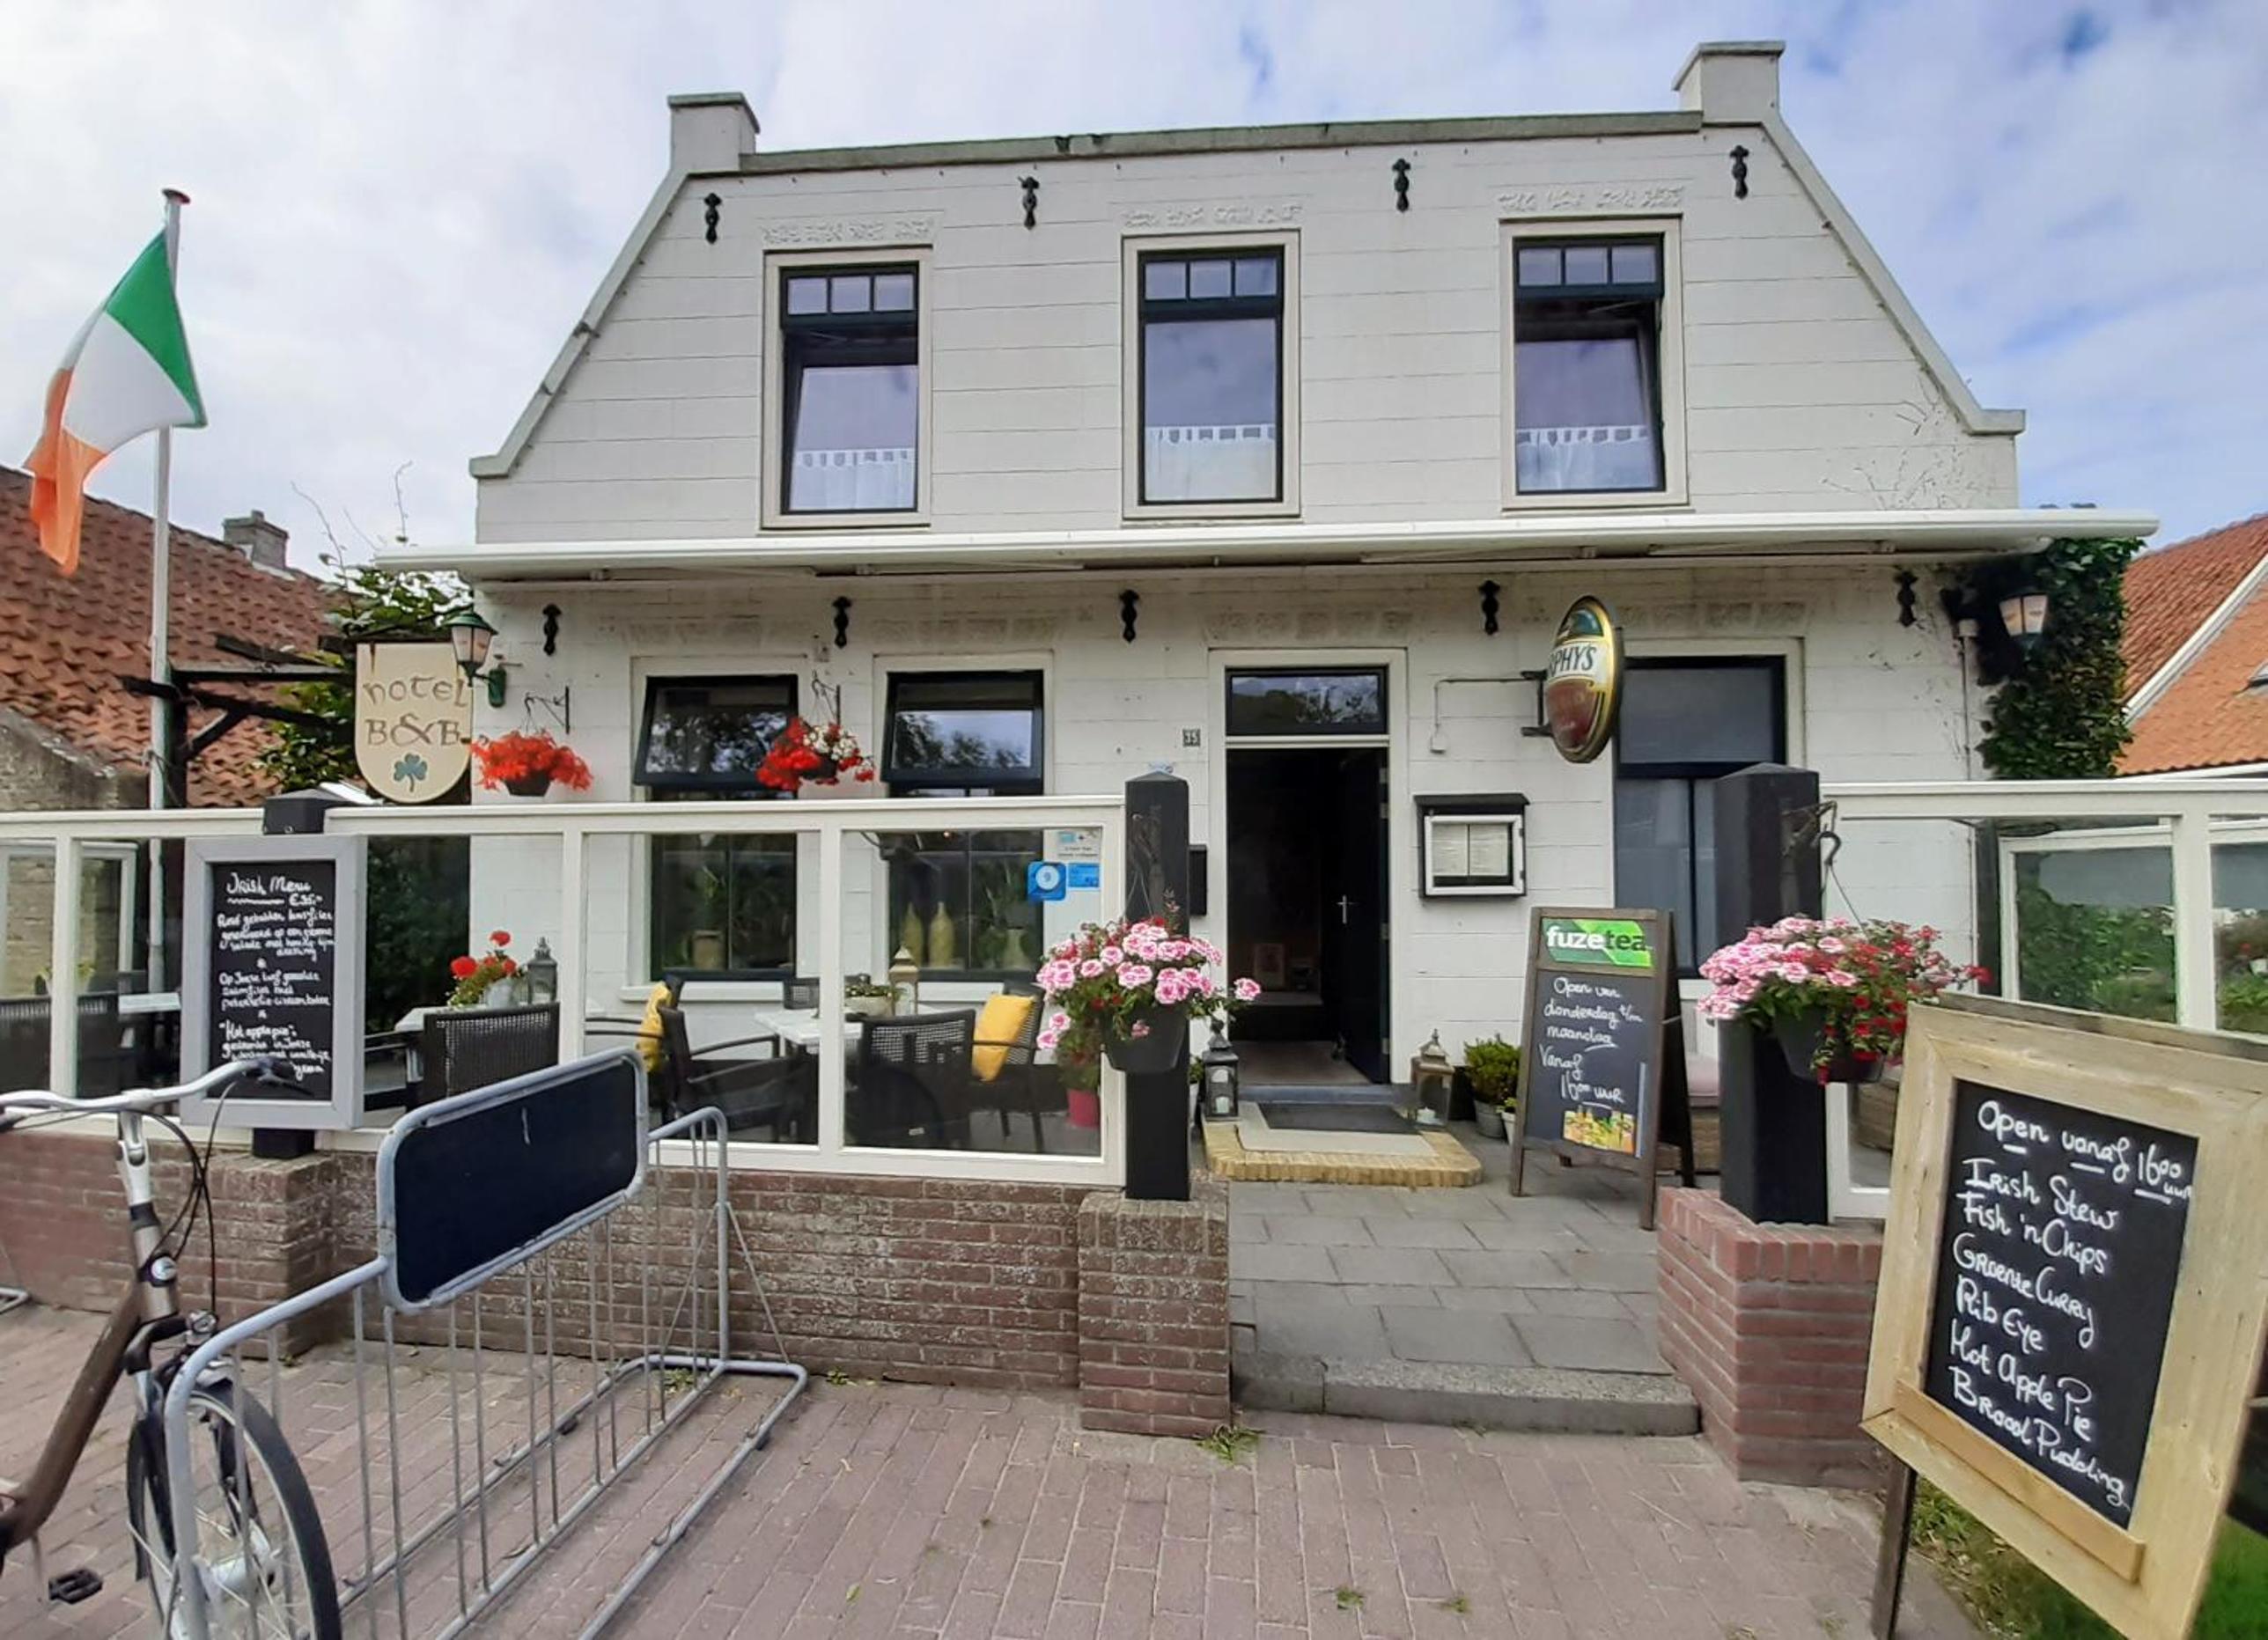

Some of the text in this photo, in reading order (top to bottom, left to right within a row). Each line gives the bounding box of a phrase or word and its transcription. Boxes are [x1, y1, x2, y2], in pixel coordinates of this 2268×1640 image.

[226, 871, 312, 895] Irish Menu
[1543, 997, 1620, 1030] donderdag
[1553, 976, 1592, 998] Open
[1977, 1100, 2050, 1142] Open
[2061, 1136, 2131, 1184] vanaf
[1955, 1190, 2012, 1236] Fish
[2042, 1217, 2108, 1275] Chips
[1962, 1158, 2118, 1230] Irish Stew
[1955, 1274, 2044, 1354] Rib Eye
[2035, 1266, 2095, 1349] Curry
[1950, 1318, 1992, 1375] Hot
[2057, 1377, 2093, 1442] Pie
[1948, 1365, 2131, 1512] Brood Pudding
